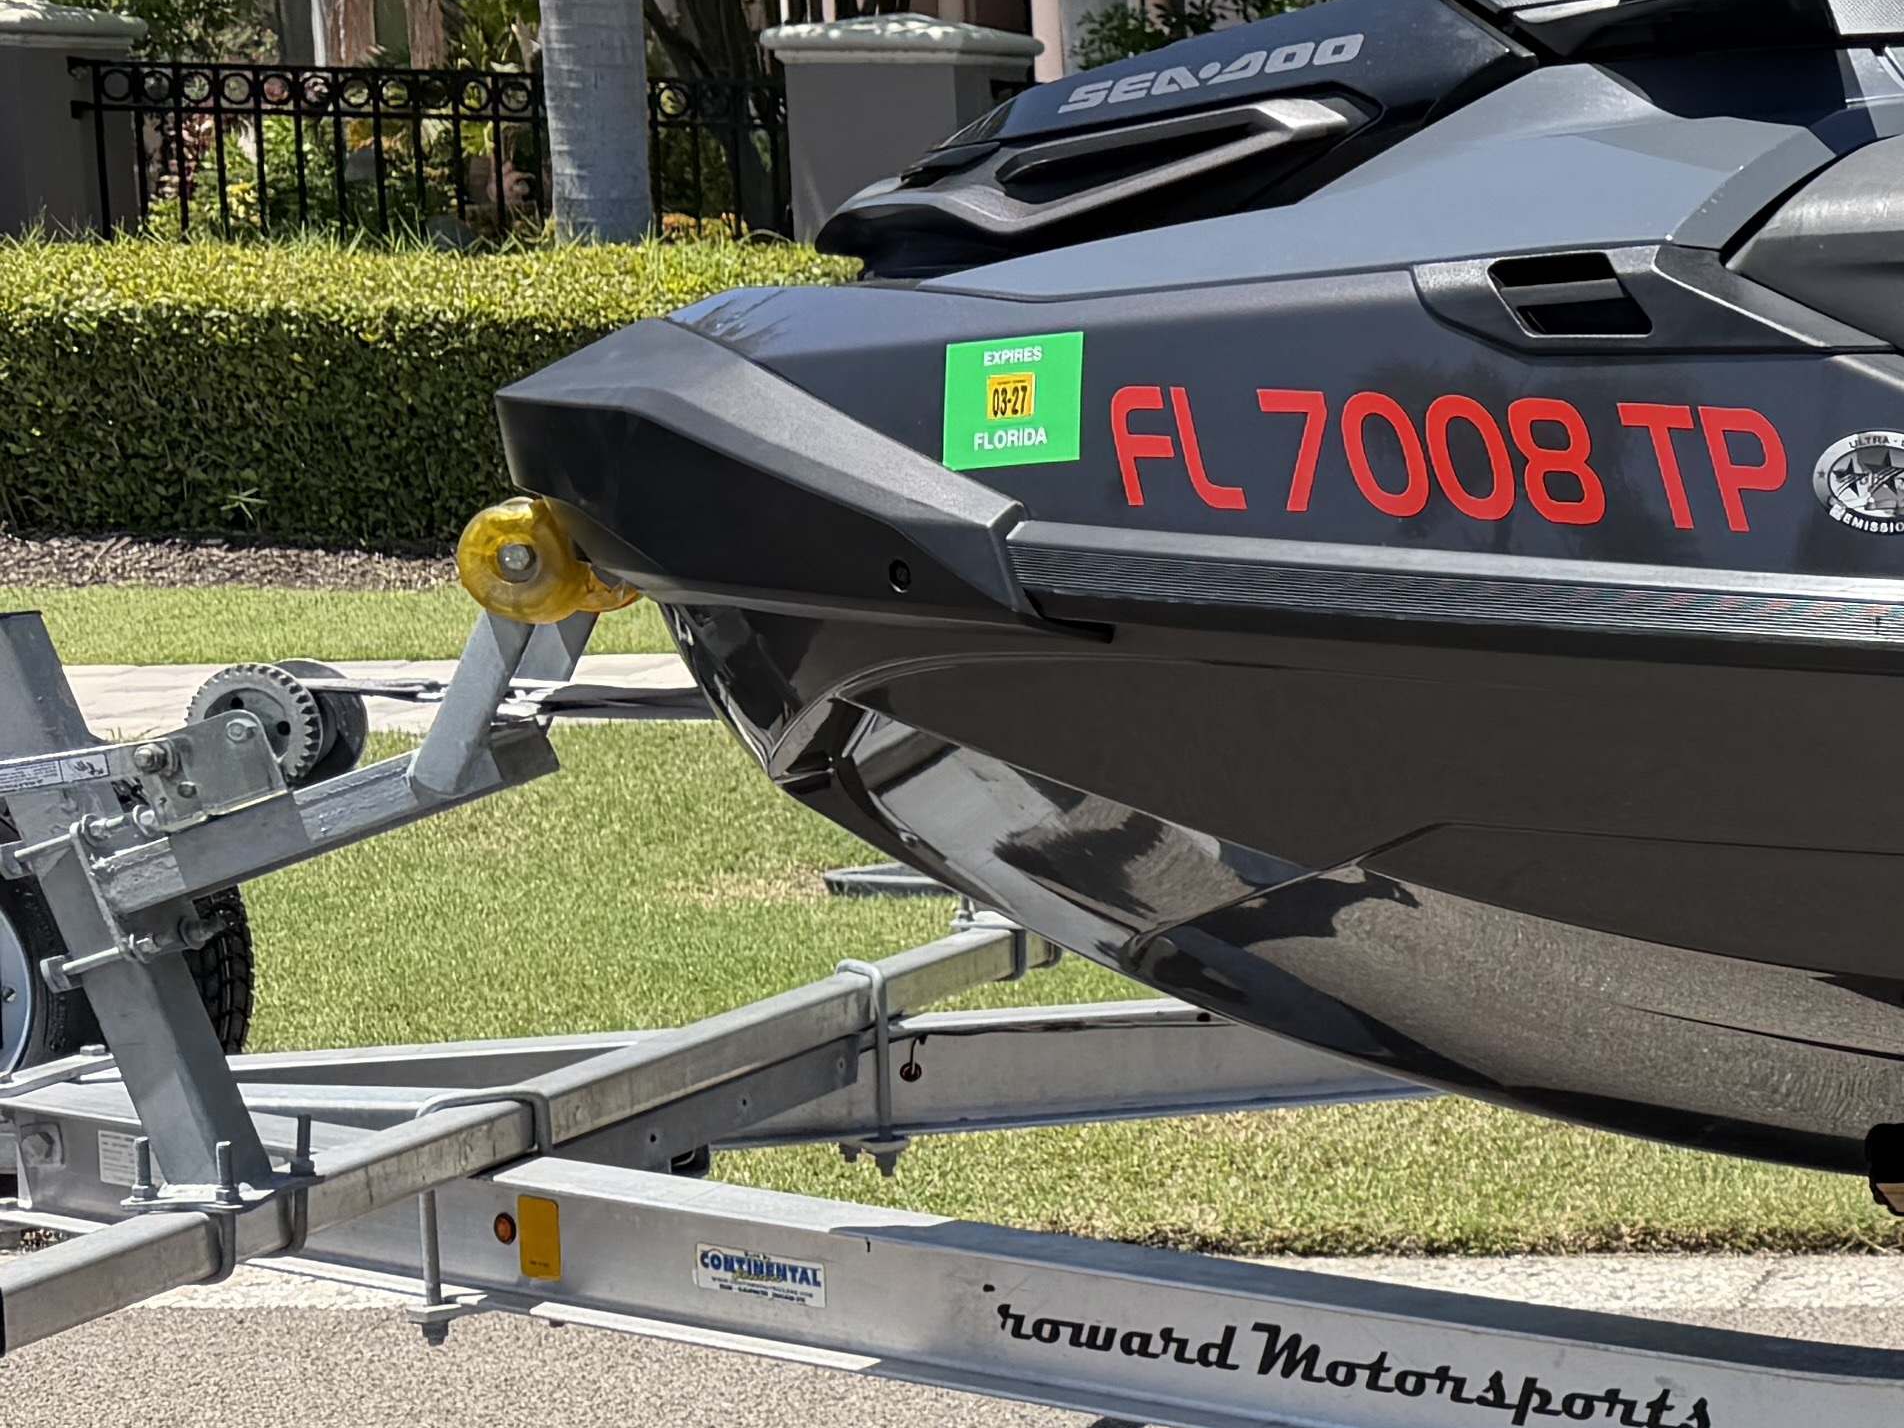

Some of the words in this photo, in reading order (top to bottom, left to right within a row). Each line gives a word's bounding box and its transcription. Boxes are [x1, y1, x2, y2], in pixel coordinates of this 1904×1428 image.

[983, 346, 1043, 366] EXPIRES
[992, 385, 1028, 417] 03-27
[973, 427, 1048, 451] FLORIDA
[1848, 435, 1891, 449] ULTRA
[1110, 385, 1246, 509] FL
[1257, 387, 1606, 523] 7008
[1616, 401, 1788, 533] TP
[700, 1250, 822, 1287] CONTINENTAL
